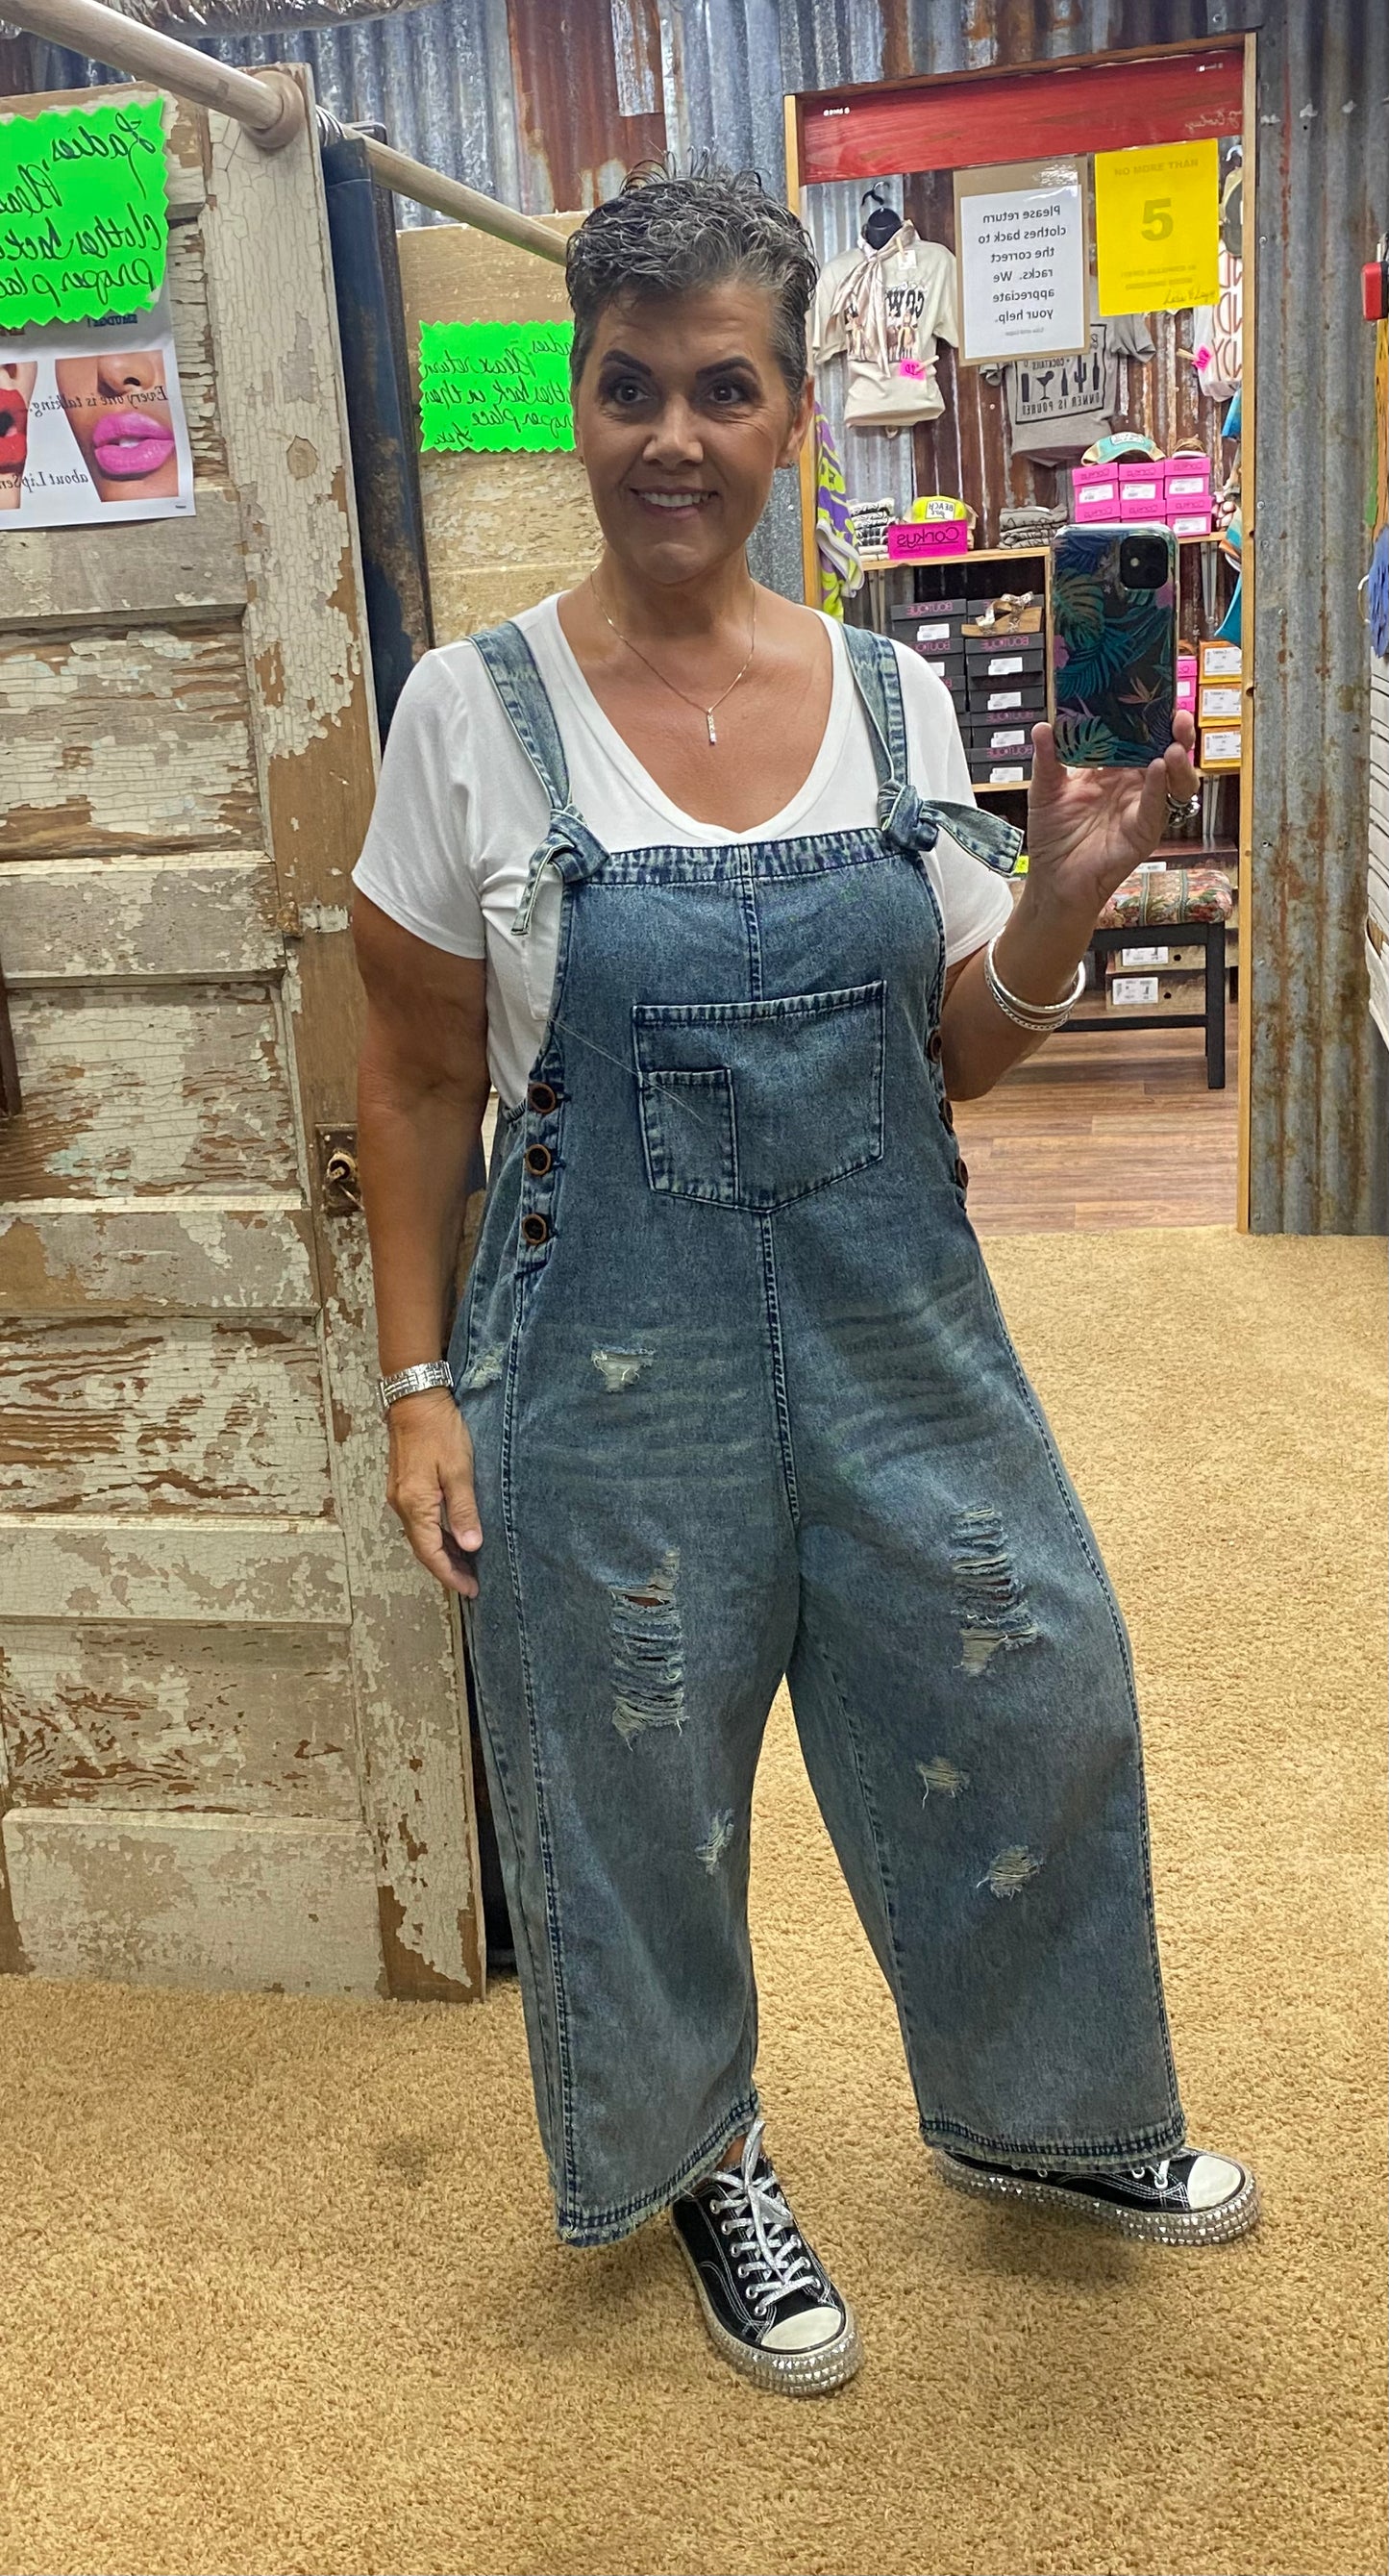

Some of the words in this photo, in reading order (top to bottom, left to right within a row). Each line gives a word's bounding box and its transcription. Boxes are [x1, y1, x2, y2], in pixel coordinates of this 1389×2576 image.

[1114, 167, 1130, 177] NO
[1133, 162, 1164, 175] MORE
[1168, 159, 1199, 170] THAN
[1141, 197, 1174, 241] 5
